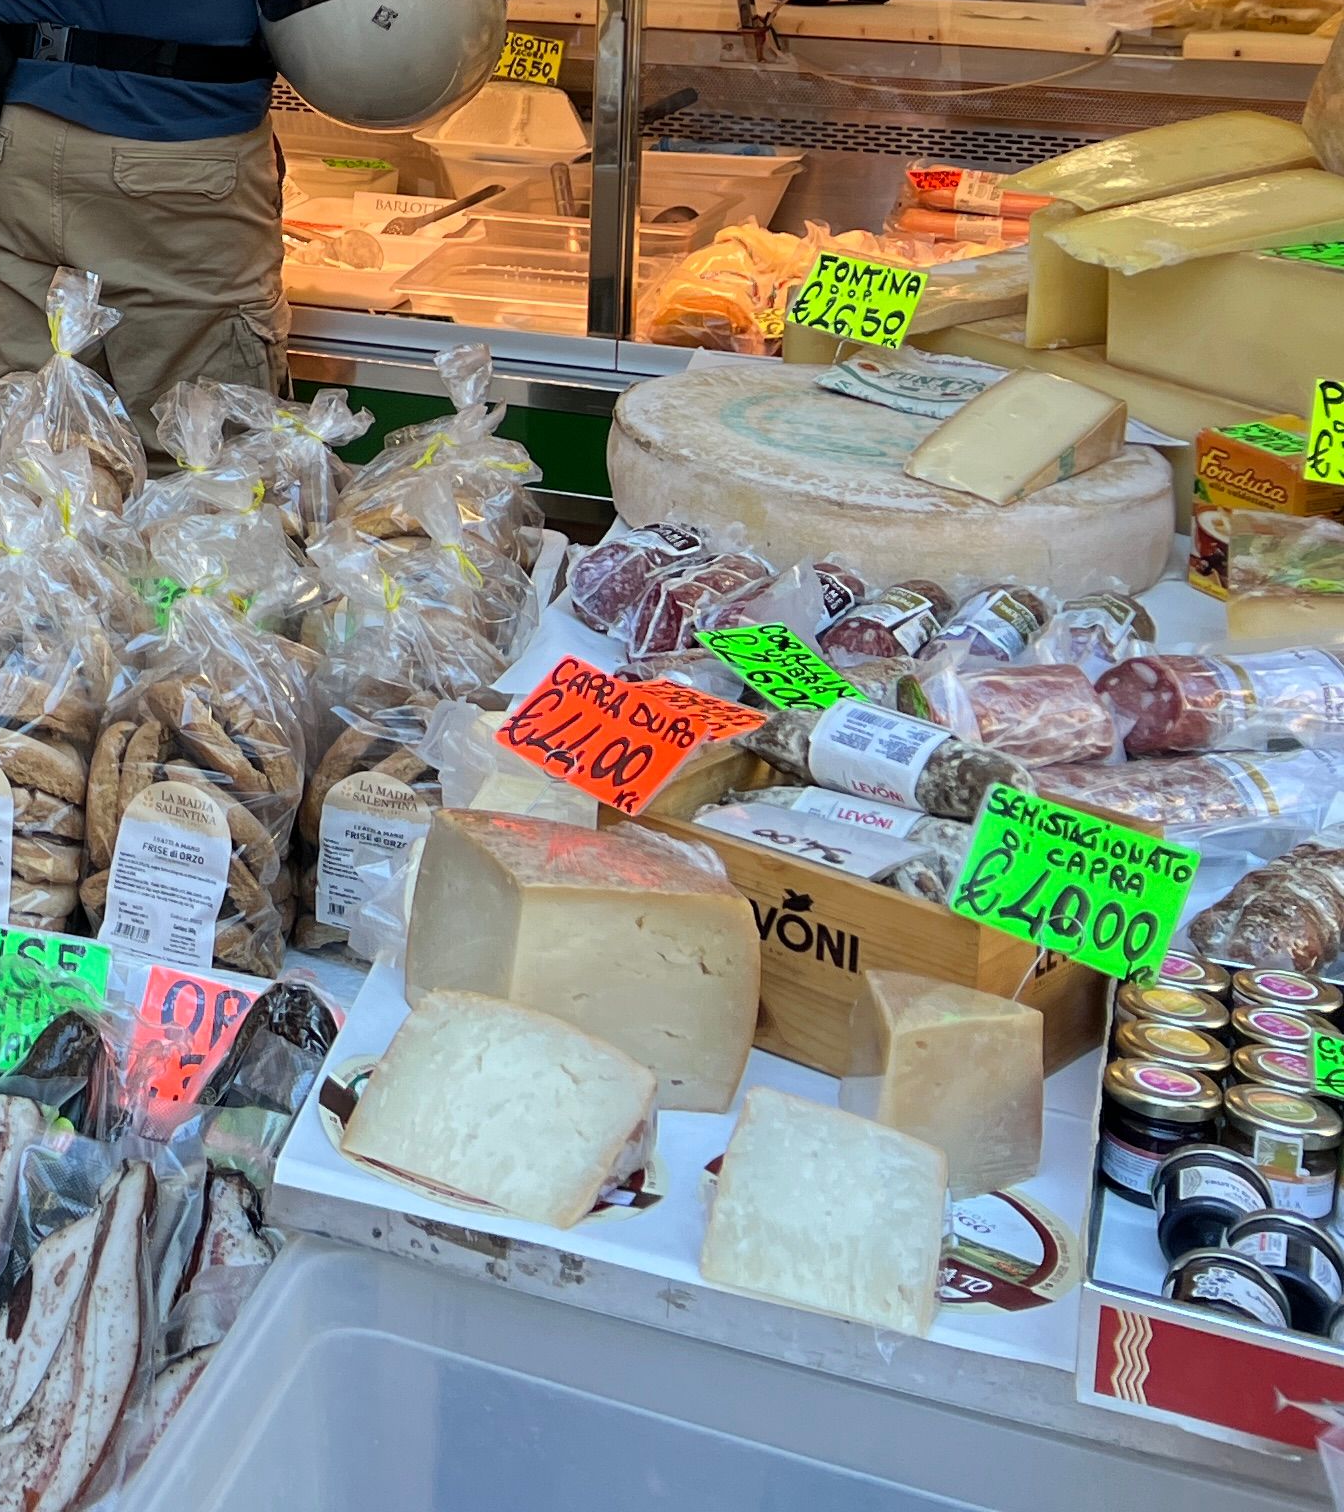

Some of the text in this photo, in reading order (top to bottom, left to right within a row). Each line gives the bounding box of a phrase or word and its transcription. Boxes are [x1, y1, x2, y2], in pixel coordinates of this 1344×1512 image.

[818, 253, 922, 298] FONTINA
[1200, 447, 1288, 504] Fonduta
[550, 659, 630, 719] CAPRA
[629, 702, 697, 750] DURO
[160, 789, 214, 815] LA MADIA
[351, 791, 418, 813] SALENTINA
[359, 779, 417, 802] LA MADIA
[850, 778, 906, 804] LEVONI
[155, 800, 217, 828] SALENTINA
[836, 806, 894, 830] LEVONI
[988, 782, 1196, 885] SEMISTAGIONATO
[1047, 848, 1146, 899] CAPRA
